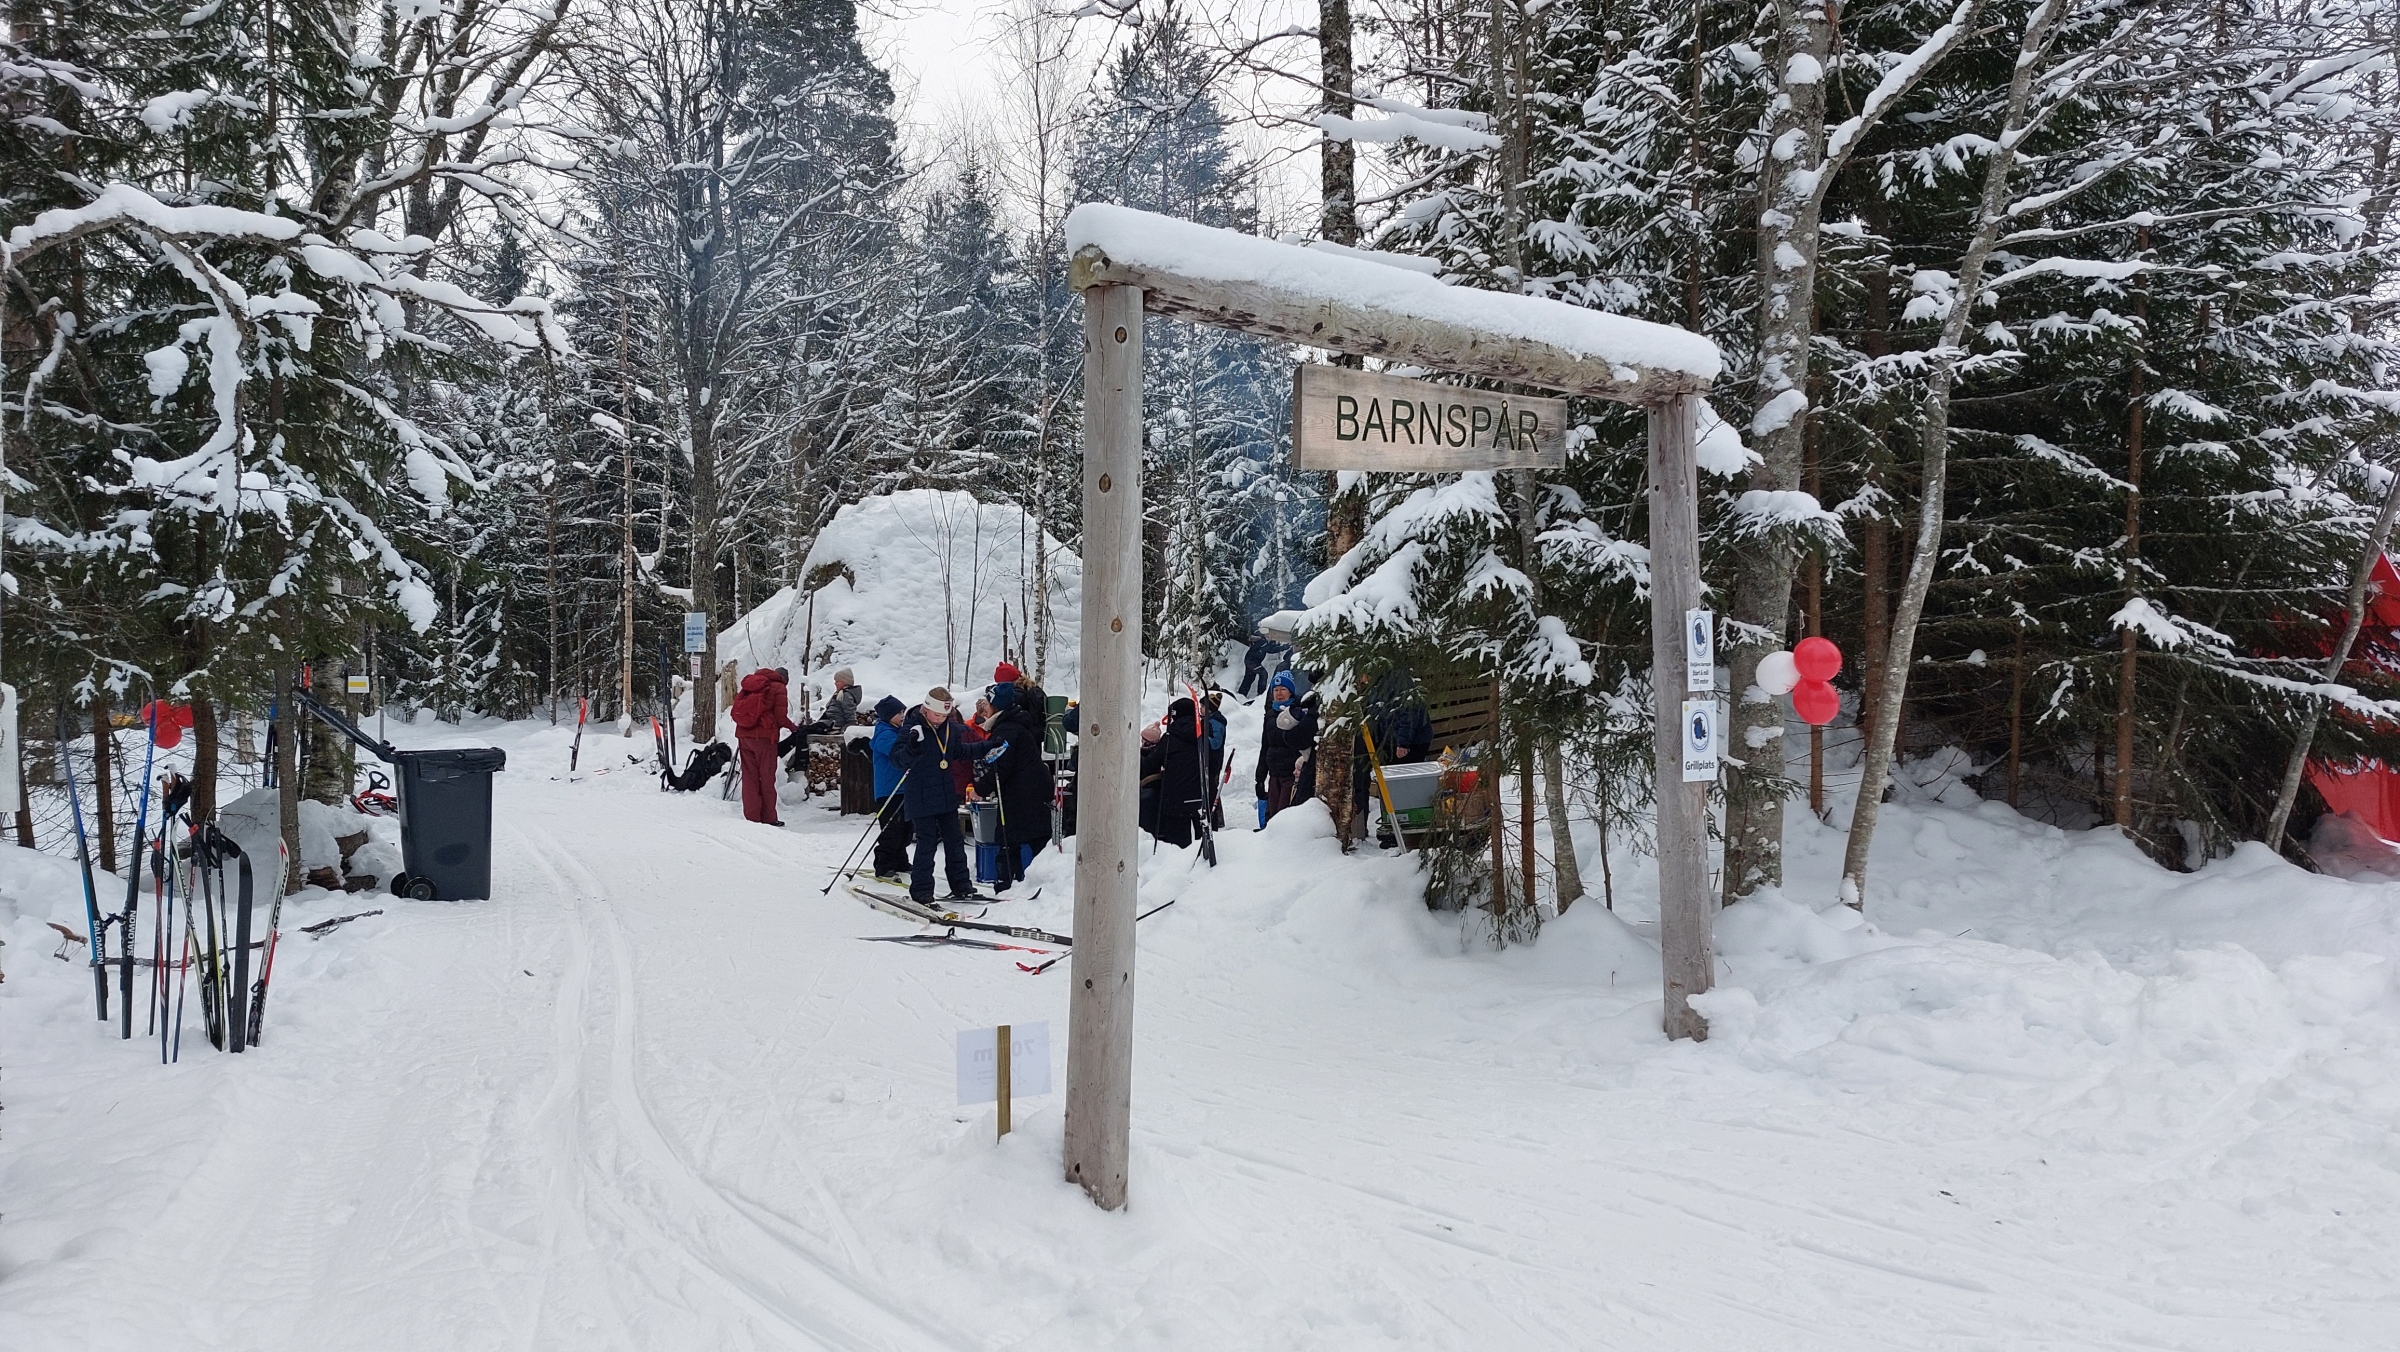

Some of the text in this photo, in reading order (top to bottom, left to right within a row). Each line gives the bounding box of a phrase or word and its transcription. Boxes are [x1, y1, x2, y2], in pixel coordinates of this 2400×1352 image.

[1336, 395, 1540, 452] BARNSPÅR
[141, 739, 153, 799] SALOMON
[1685, 759, 1715, 772] Grillplats
[273, 861, 289, 929] MADSHUS
[92, 919, 105, 965] SALOMON
[126, 910, 137, 956] SALOMON
